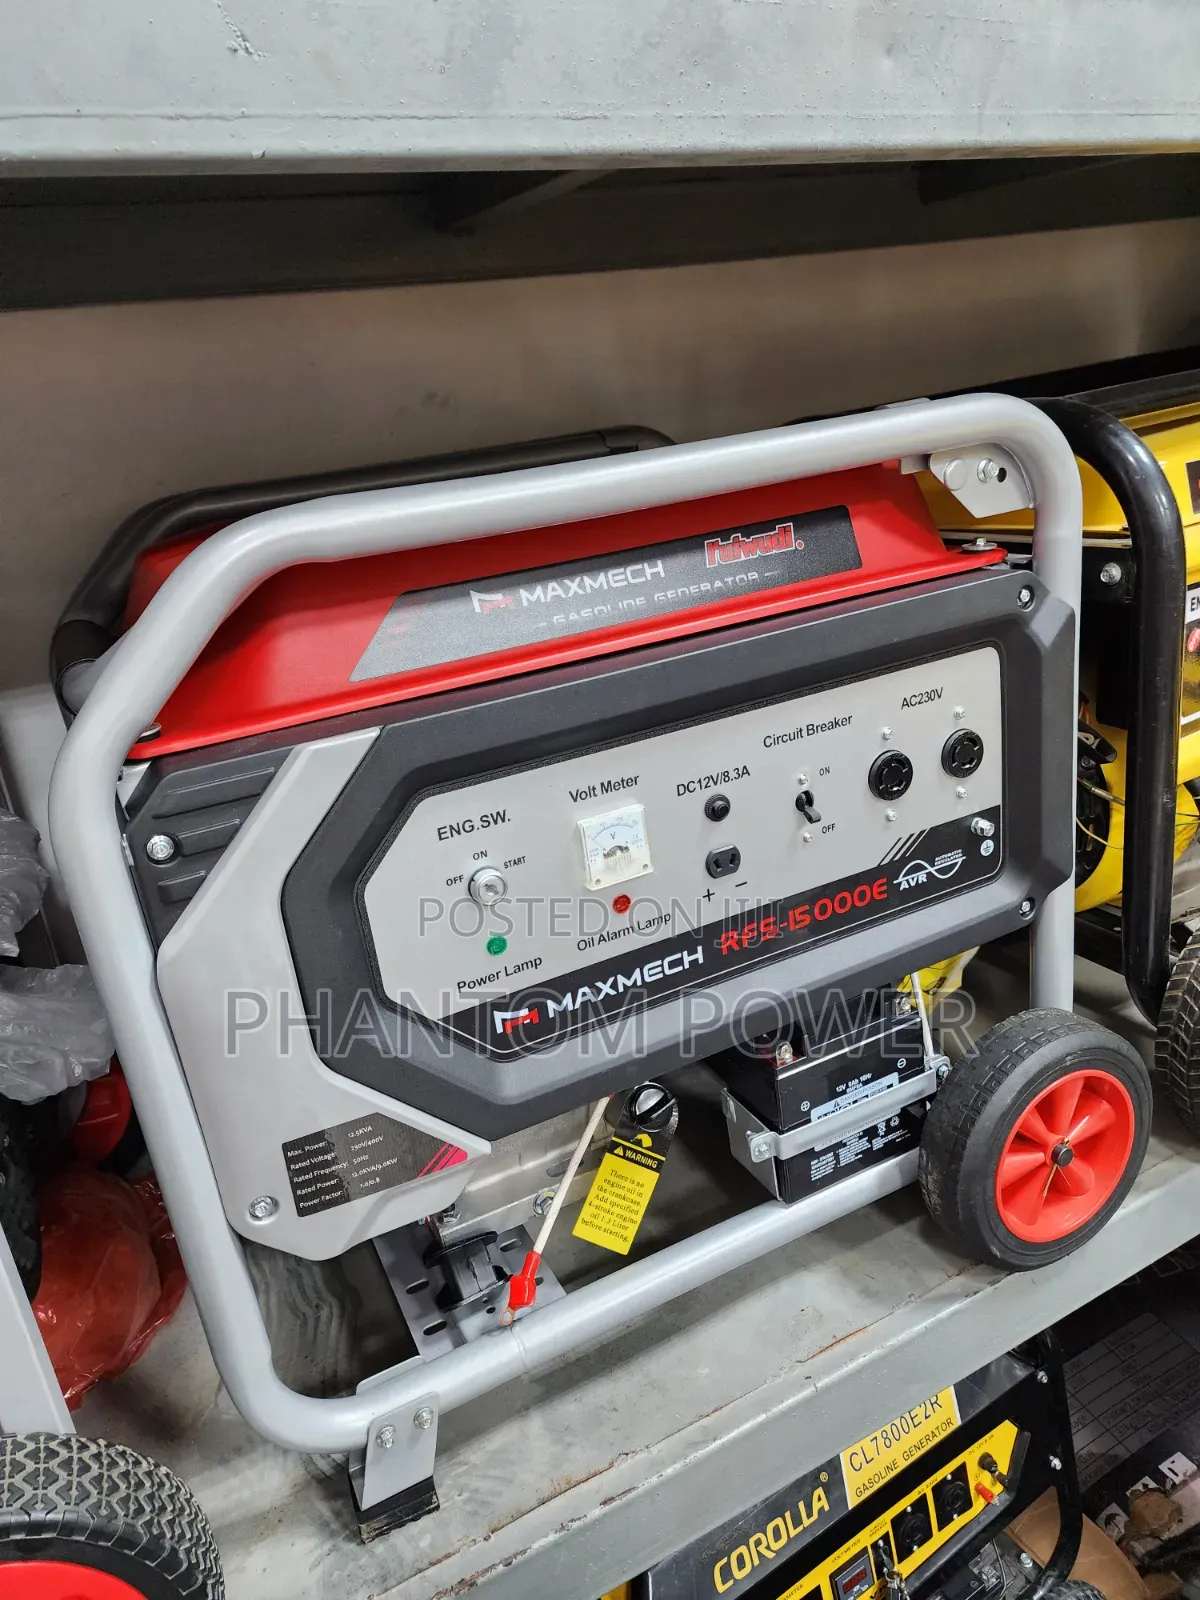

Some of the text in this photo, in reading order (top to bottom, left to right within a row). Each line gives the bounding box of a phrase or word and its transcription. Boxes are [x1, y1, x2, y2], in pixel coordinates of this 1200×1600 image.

[705, 522, 796, 568] ruiwudi
[519, 560, 665, 607] MAXMECH
[654, 571, 759, 604] GENERATOR
[901, 687, 944, 710] AC230V
[763, 714, 853, 748] Circuit Breaker
[676, 764, 751, 797] DC12V/8.3A
[818, 766, 831, 777] ON
[569, 773, 640, 803] Volt Meter
[437, 809, 512, 842] ENG.SW.
[821, 823, 836, 835] OFF
[472, 849, 488, 861] ON
[503, 856, 527, 870] START
[446, 875, 464, 887] OFF
[899, 873, 928, 891] AVR
[576, 912, 672, 952] Oil Alarm Lamp
[457, 956, 543, 994] Power Lamp
[546, 946, 704, 1019] MAXMECH
[287, 1125, 373, 1158] Max. Power: 12.5KVA
[290, 1135, 384, 1171] Rated Voltage: 230V/400V
[293, 1154, 370, 1183] Rated Frequency: 50Hz
[625, 1149, 658, 1169] WARNING
[296, 1185, 316, 1196] Rated
[316, 1177, 340, 1190] Power:
[603, 1178, 643, 1198] engine oil in
[609, 1169, 629, 1182] There
[629, 1177, 635, 1185] is
[300, 1198, 320, 1209] Power
[321, 1190, 344, 1202] Factor:
[594, 1194, 639, 1216] Add specified
[597, 1185, 642, 1207] the crankcase.
[588, 1201, 638, 1225] 4-stroke engine
[590, 1211, 599, 1220] oil
[612, 1219, 630, 1232] Liter
[581, 1218, 629, 1243] before starting.
[849, 1394, 943, 1472] CL7800E2R
[855, 1417, 955, 1498] GASOLINE GENERATOR
[713, 1486, 830, 1594] COROLLA
